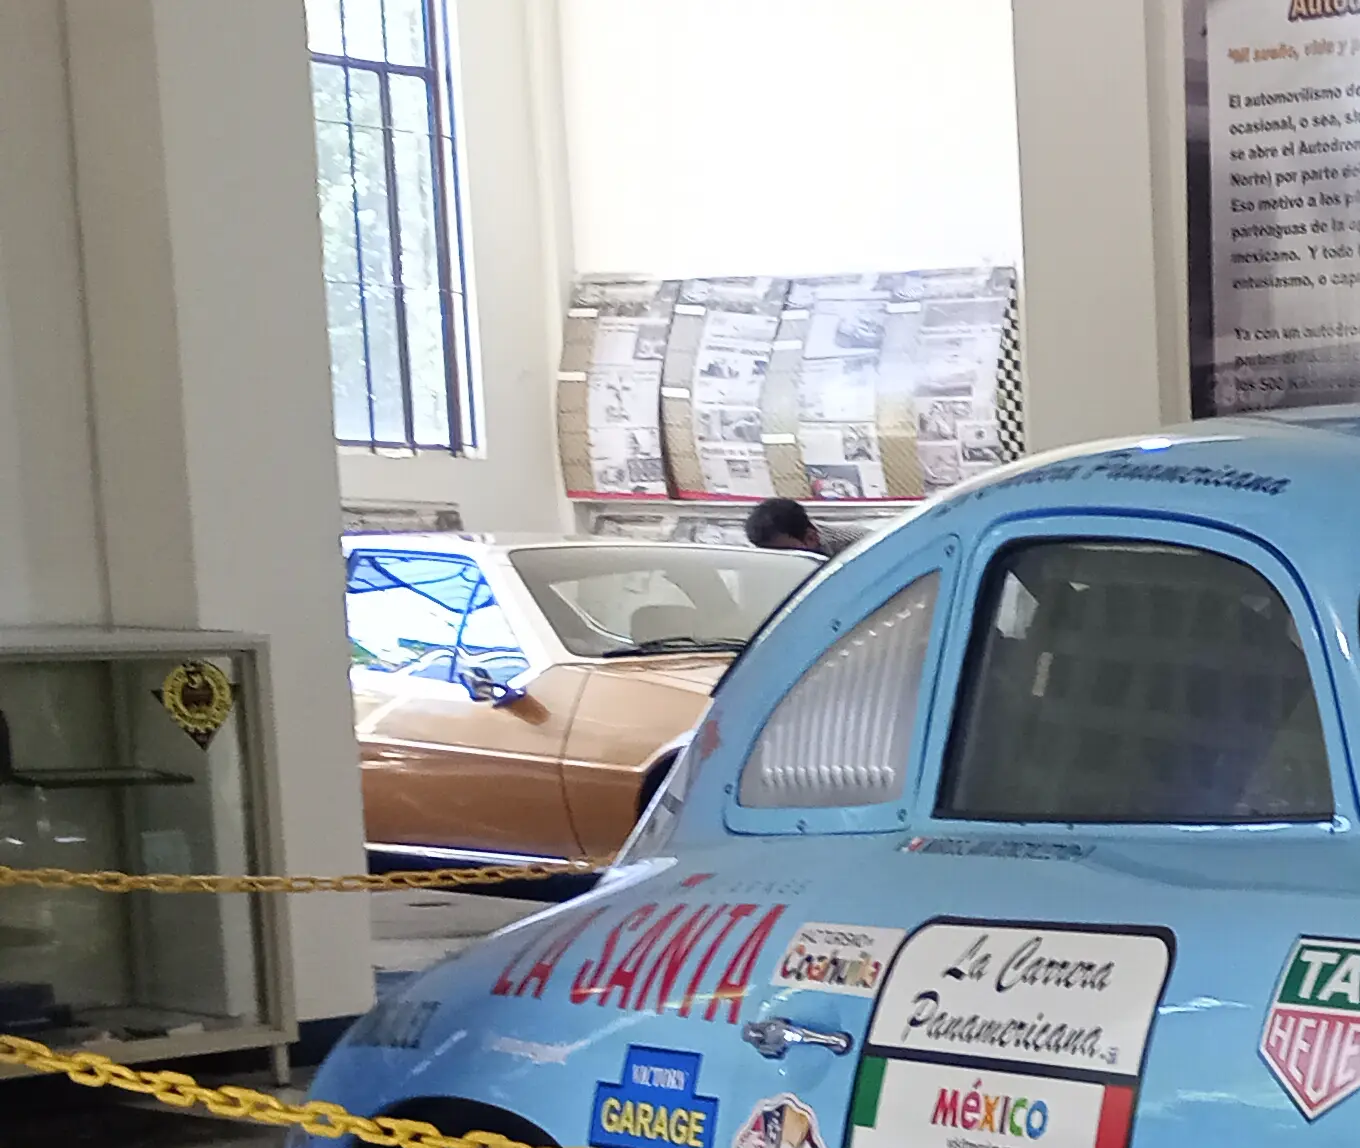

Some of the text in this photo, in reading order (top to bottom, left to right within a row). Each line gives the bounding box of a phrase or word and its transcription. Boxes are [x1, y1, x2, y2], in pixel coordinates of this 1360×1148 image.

[1244, 86, 1342, 108] automovilismo
[1282, 142, 1295, 156] el
[1275, 171, 1297, 186] por
[1301, 167, 1338, 185] parte
[1320, 192, 1341, 205] los
[491, 904, 611, 1000] LA
[569, 902, 787, 1026] SANTA
[941, 934, 1115, 992] La Carrera
[900, 990, 1104, 1061] Panamericana
[601, 1096, 707, 1148] GARAGE
